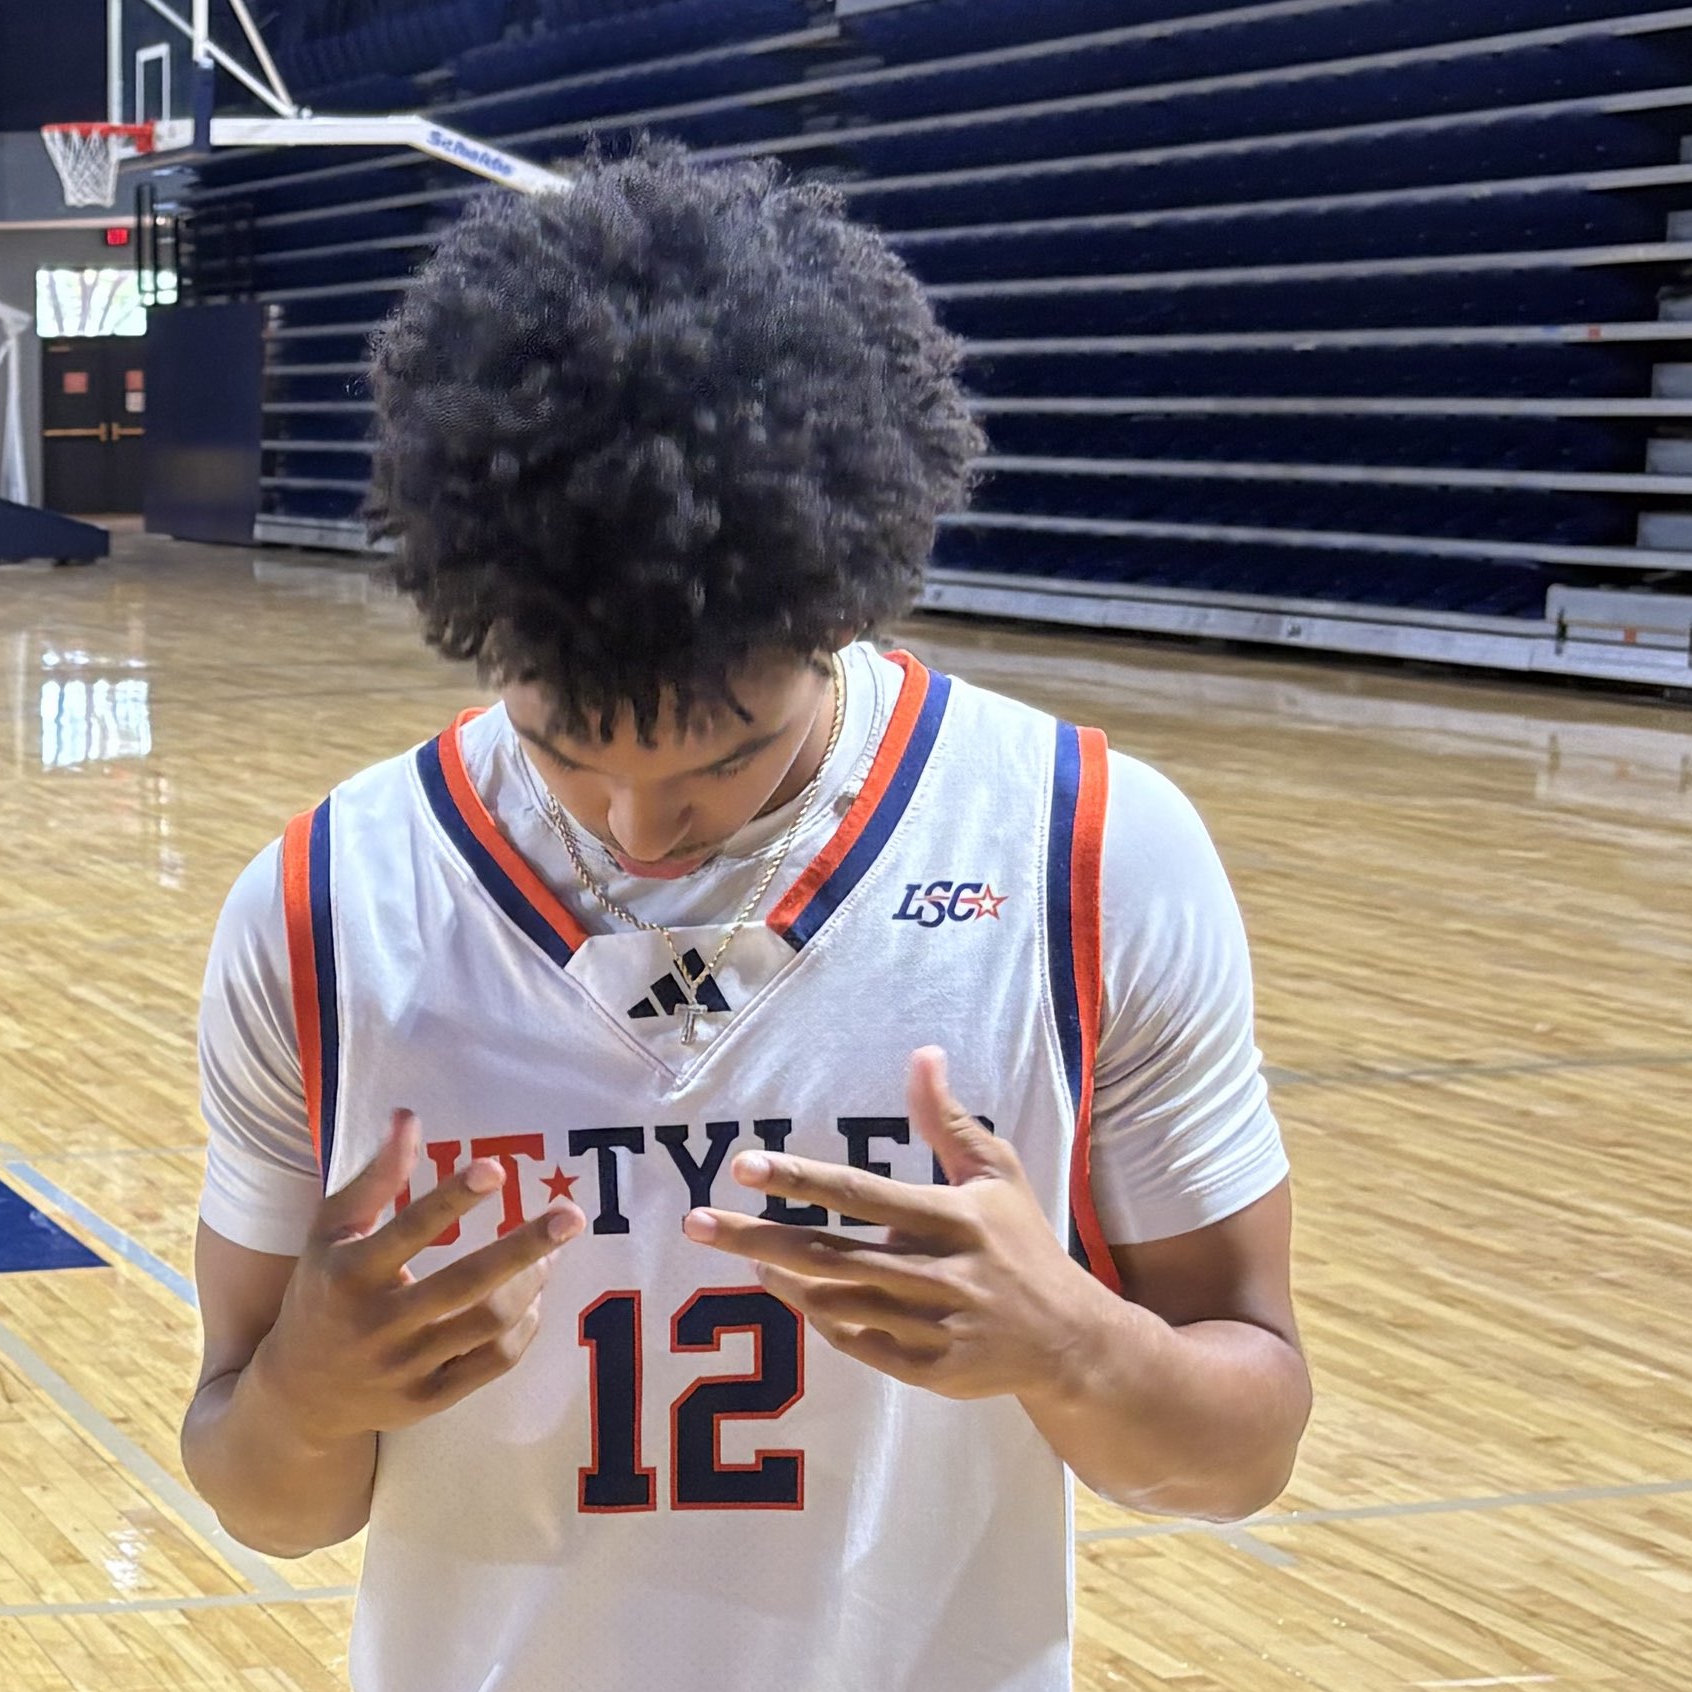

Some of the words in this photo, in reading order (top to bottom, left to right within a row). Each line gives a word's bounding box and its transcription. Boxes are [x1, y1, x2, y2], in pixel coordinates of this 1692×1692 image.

[892, 881, 983, 928] LSC
[568, 1115, 995, 1236] TYLE
[578, 1285, 805, 1513] 12
